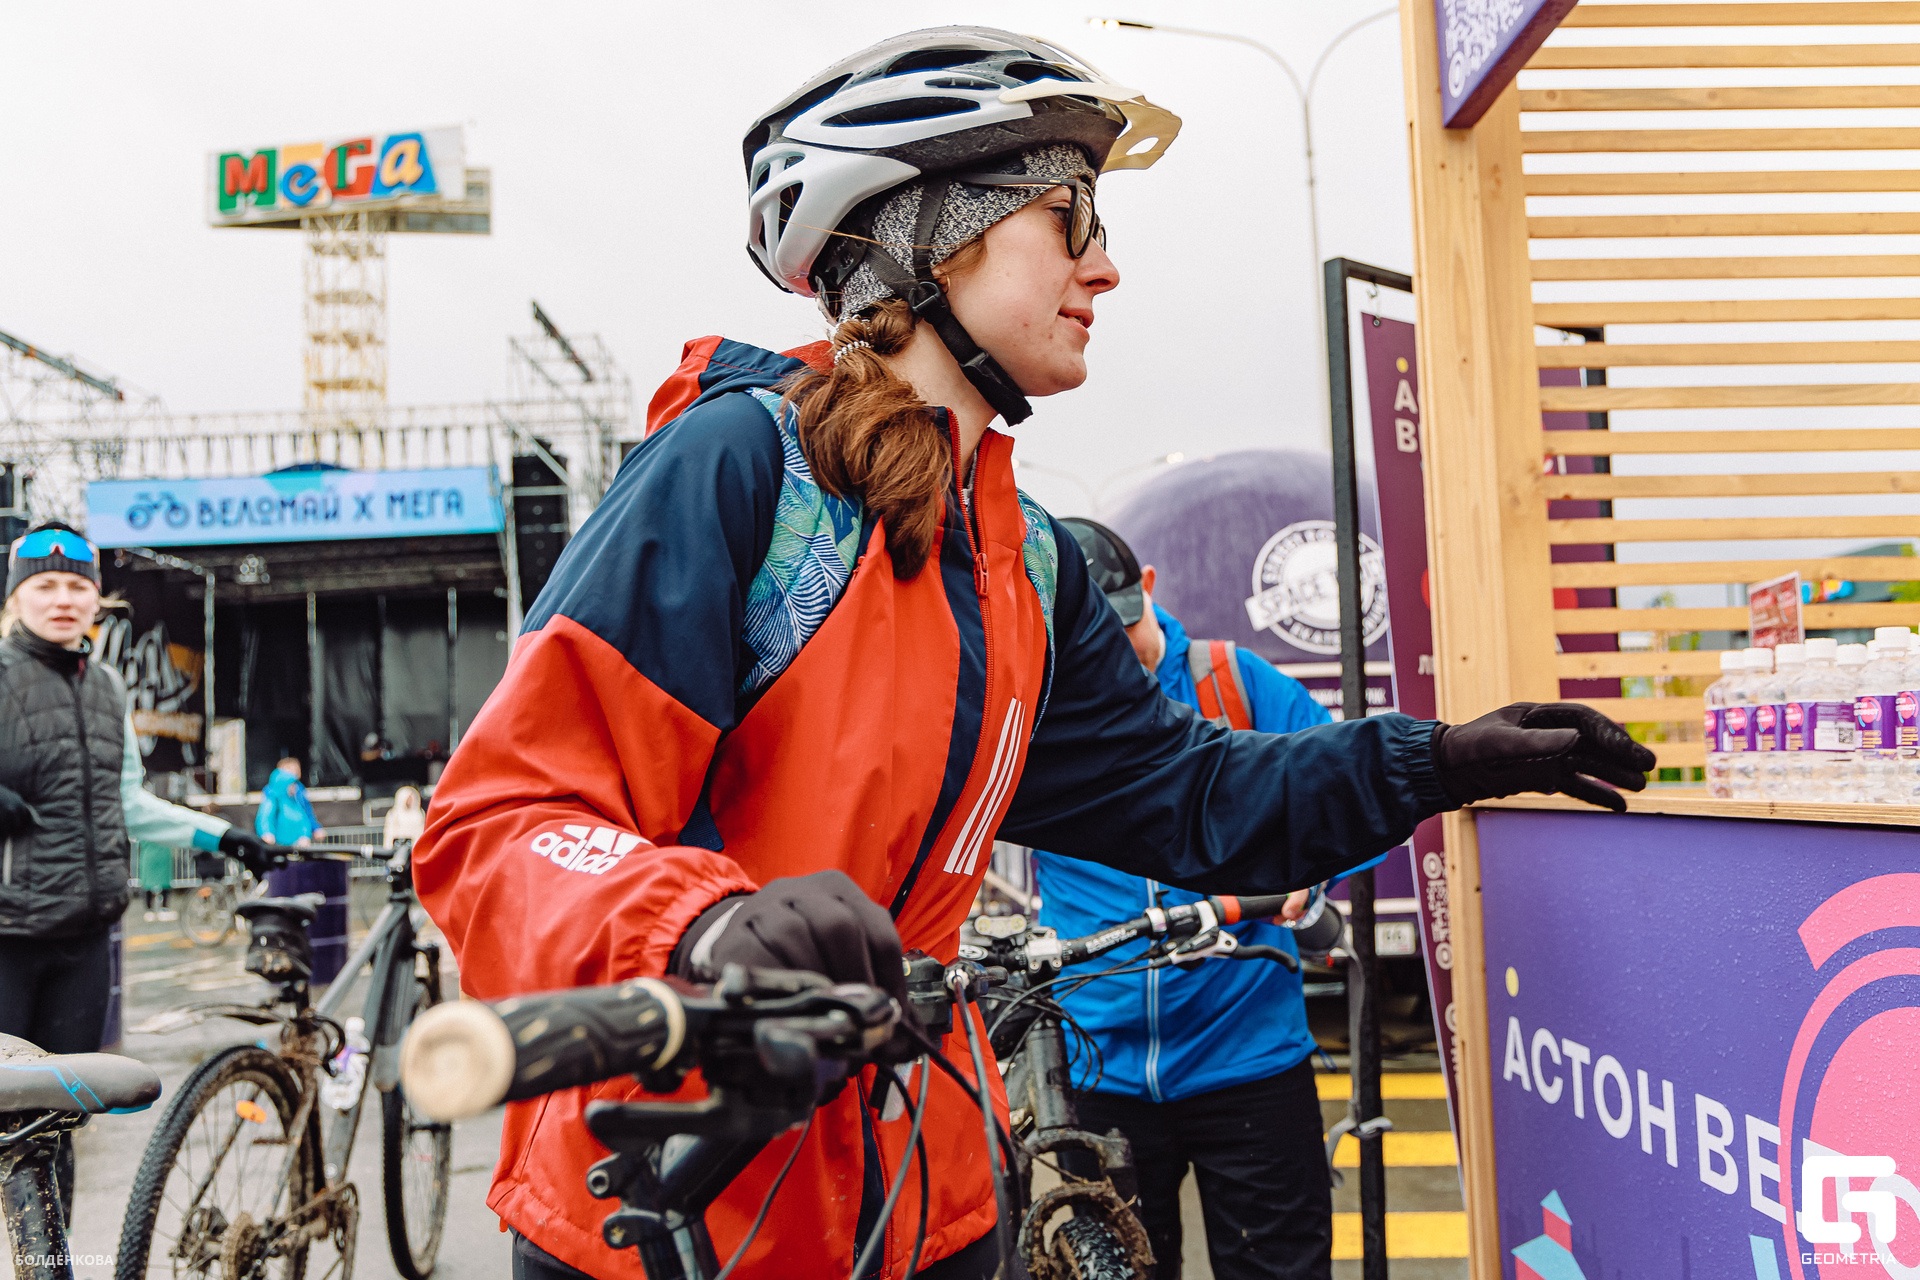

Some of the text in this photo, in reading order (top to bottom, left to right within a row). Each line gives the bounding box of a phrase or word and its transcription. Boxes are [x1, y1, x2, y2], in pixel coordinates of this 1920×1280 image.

[199, 485, 340, 527] ВЕЛОМАЙ
[386, 487, 464, 520] МЕГА
[1503, 1016, 1678, 1168] АСТОН
